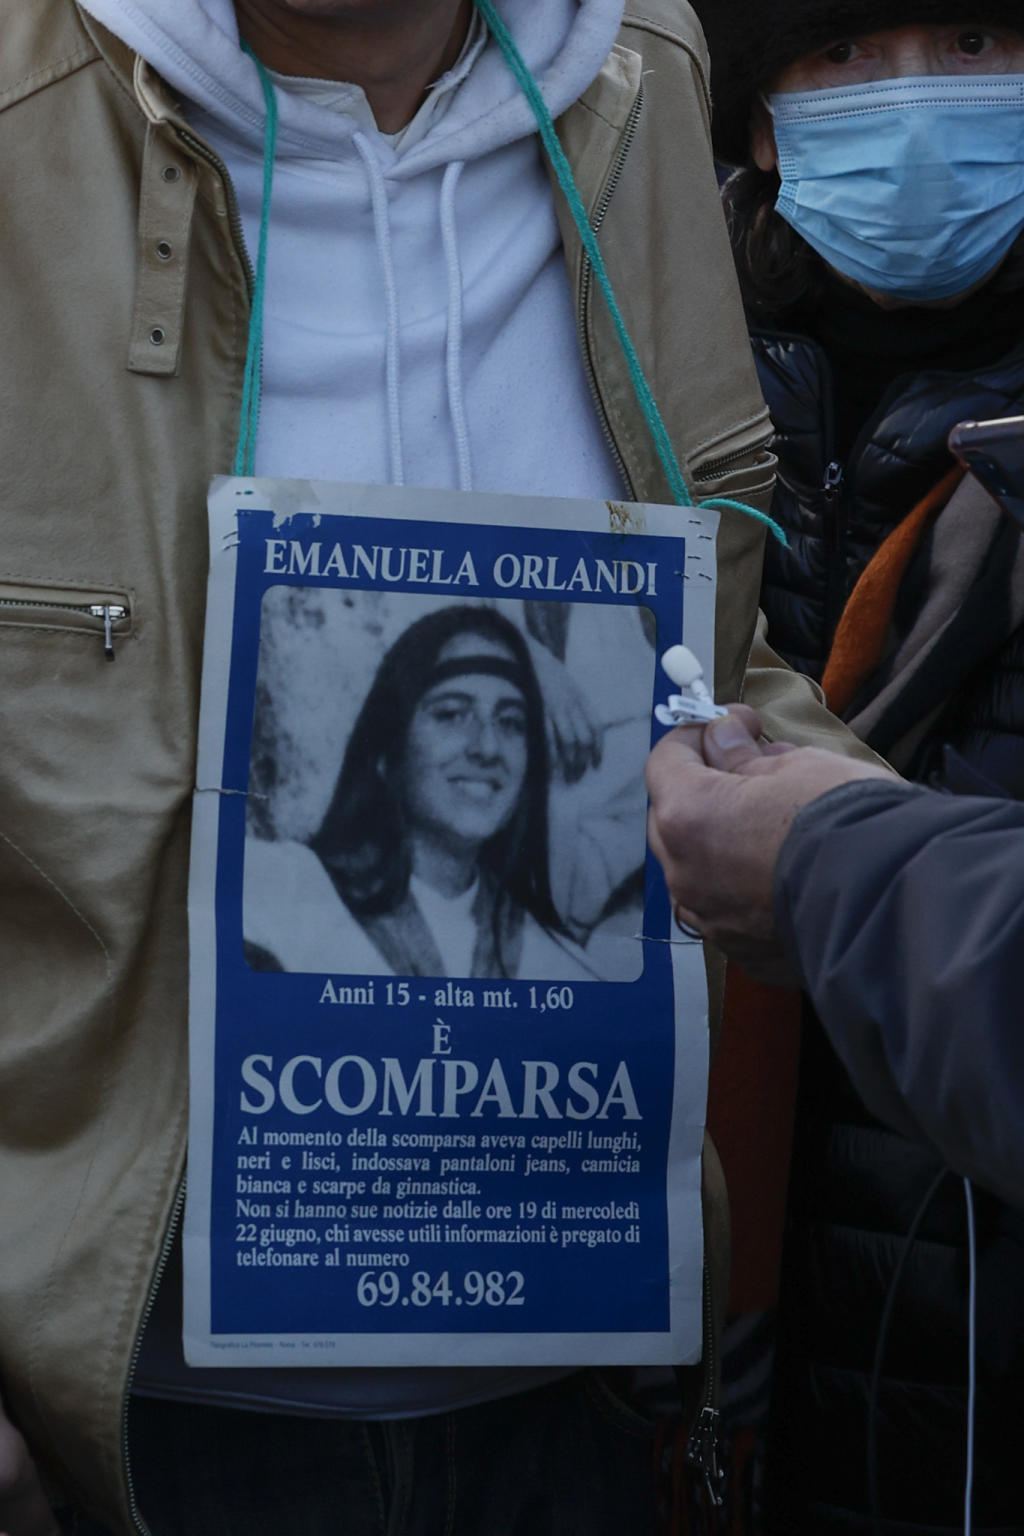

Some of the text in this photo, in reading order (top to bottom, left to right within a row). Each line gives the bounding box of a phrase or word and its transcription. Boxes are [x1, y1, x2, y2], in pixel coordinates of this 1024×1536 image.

[263, 538, 658, 596] EMANUELA ORLANDI
[319, 979, 375, 1005] Anni
[385, 982, 410, 1006] 15
[434, 981, 475, 1007] alta
[482, 987, 518, 1009] mt.
[529, 986, 574, 1013] 1,60
[431, 1017, 452, 1055] È
[239, 1054, 643, 1120] SCOMPARSA
[237, 1125, 642, 1154] Al momento della scomparsa aveva capelli lunghi,
[237, 1150, 641, 1177] neri e lisci, indossava pantaloni jeans, camicia
[236, 1173, 481, 1200] bianca e scarpe da ginnastica.
[236, 1198, 640, 1220] Non si hanno sue notizie dalle ore 19 di mercoledì
[235, 1223, 641, 1248] 22 giugno, chi avesse utili informazioni è pregato di
[236, 1247, 410, 1267] telefonare al numero
[356, 1270, 525, 1307] 69.84.982
